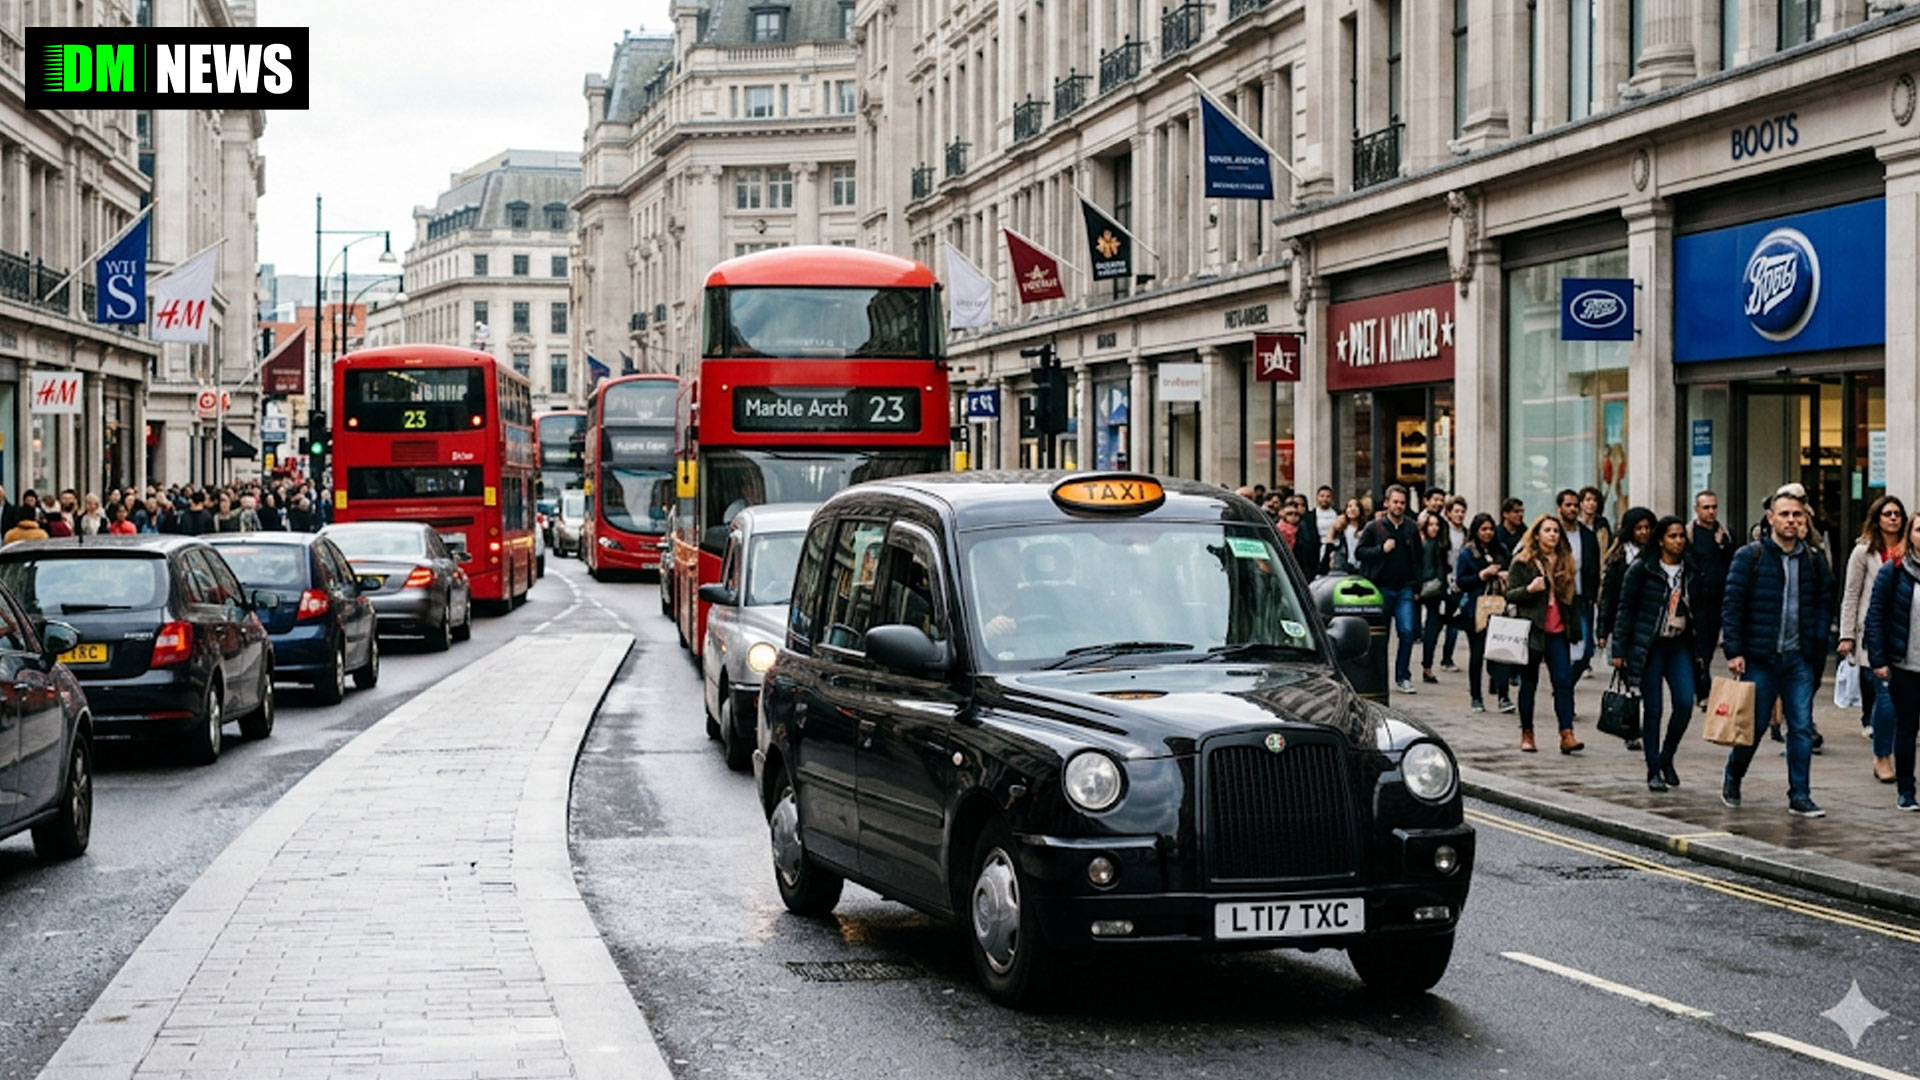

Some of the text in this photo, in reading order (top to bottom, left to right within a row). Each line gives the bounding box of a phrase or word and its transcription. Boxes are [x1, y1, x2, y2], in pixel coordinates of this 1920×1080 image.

[1731, 112, 1799, 161] BOOTS
[106, 274, 137, 319] S
[1379, 317, 1388, 363] A
[404, 410, 427, 428] 23
[745, 396, 905, 423] Marble Arch 23
[1082, 482, 1144, 500] TAXI
[1232, 902, 1349, 931] LT17 TXC
